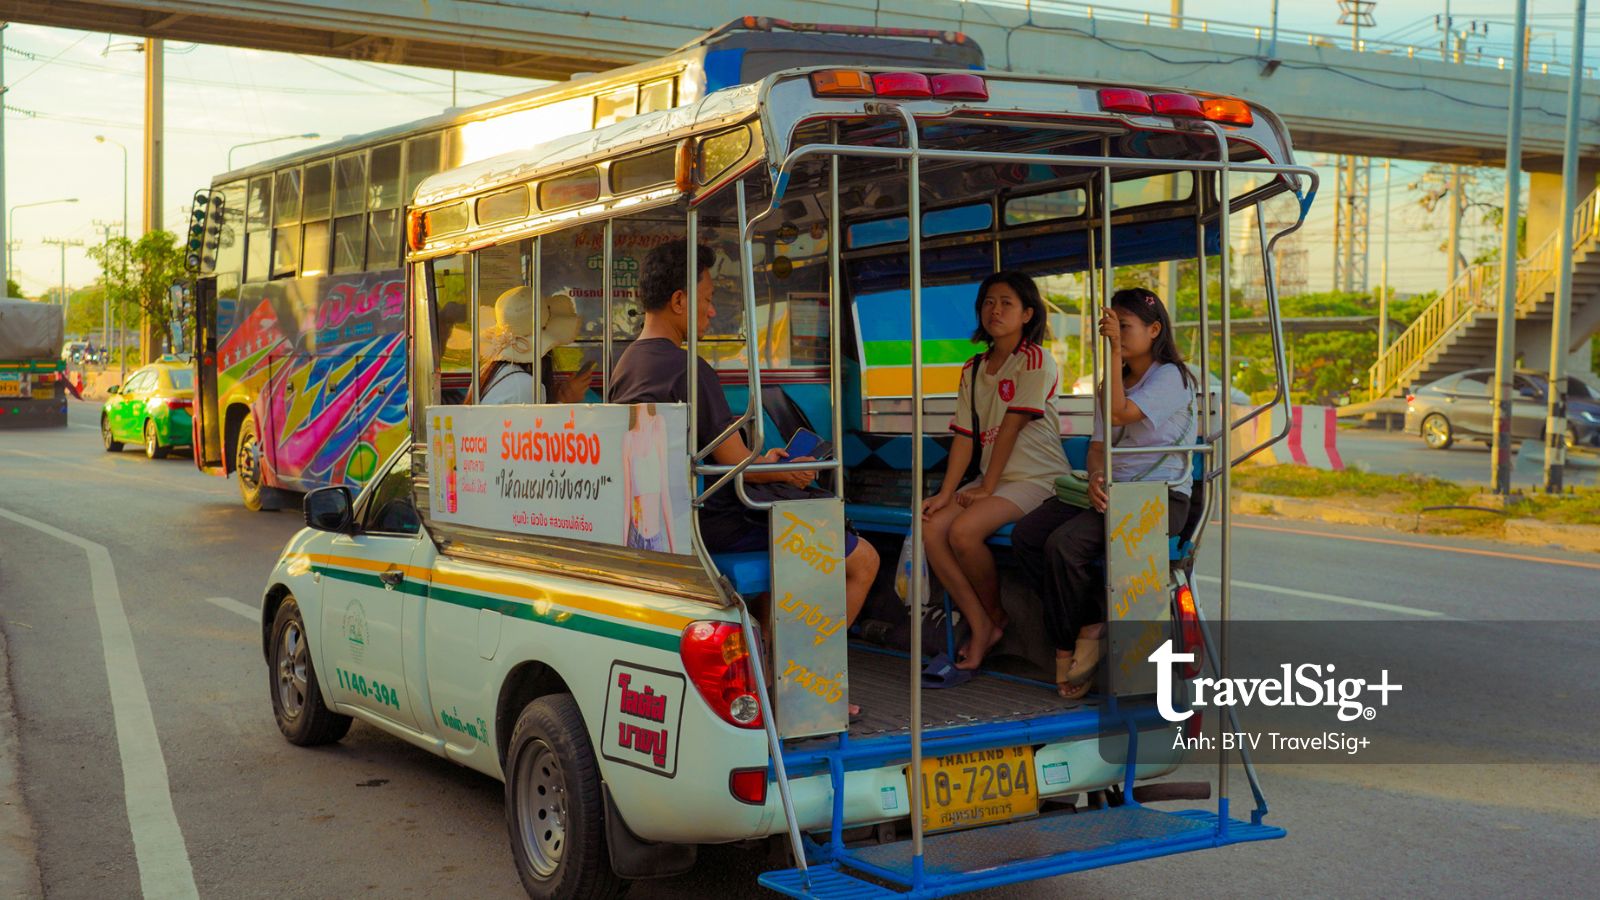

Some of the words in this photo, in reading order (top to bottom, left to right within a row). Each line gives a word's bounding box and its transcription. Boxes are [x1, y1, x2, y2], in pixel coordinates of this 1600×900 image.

[501, 408, 601, 465] รับสร้างเรื่อง
[336, 667, 401, 711] 1140-394
[618, 672, 667, 724] โลตัส
[618, 721, 668, 769] บางปู
[937, 749, 1004, 768] THAILAND
[922, 760, 1029, 809] 10-7204
